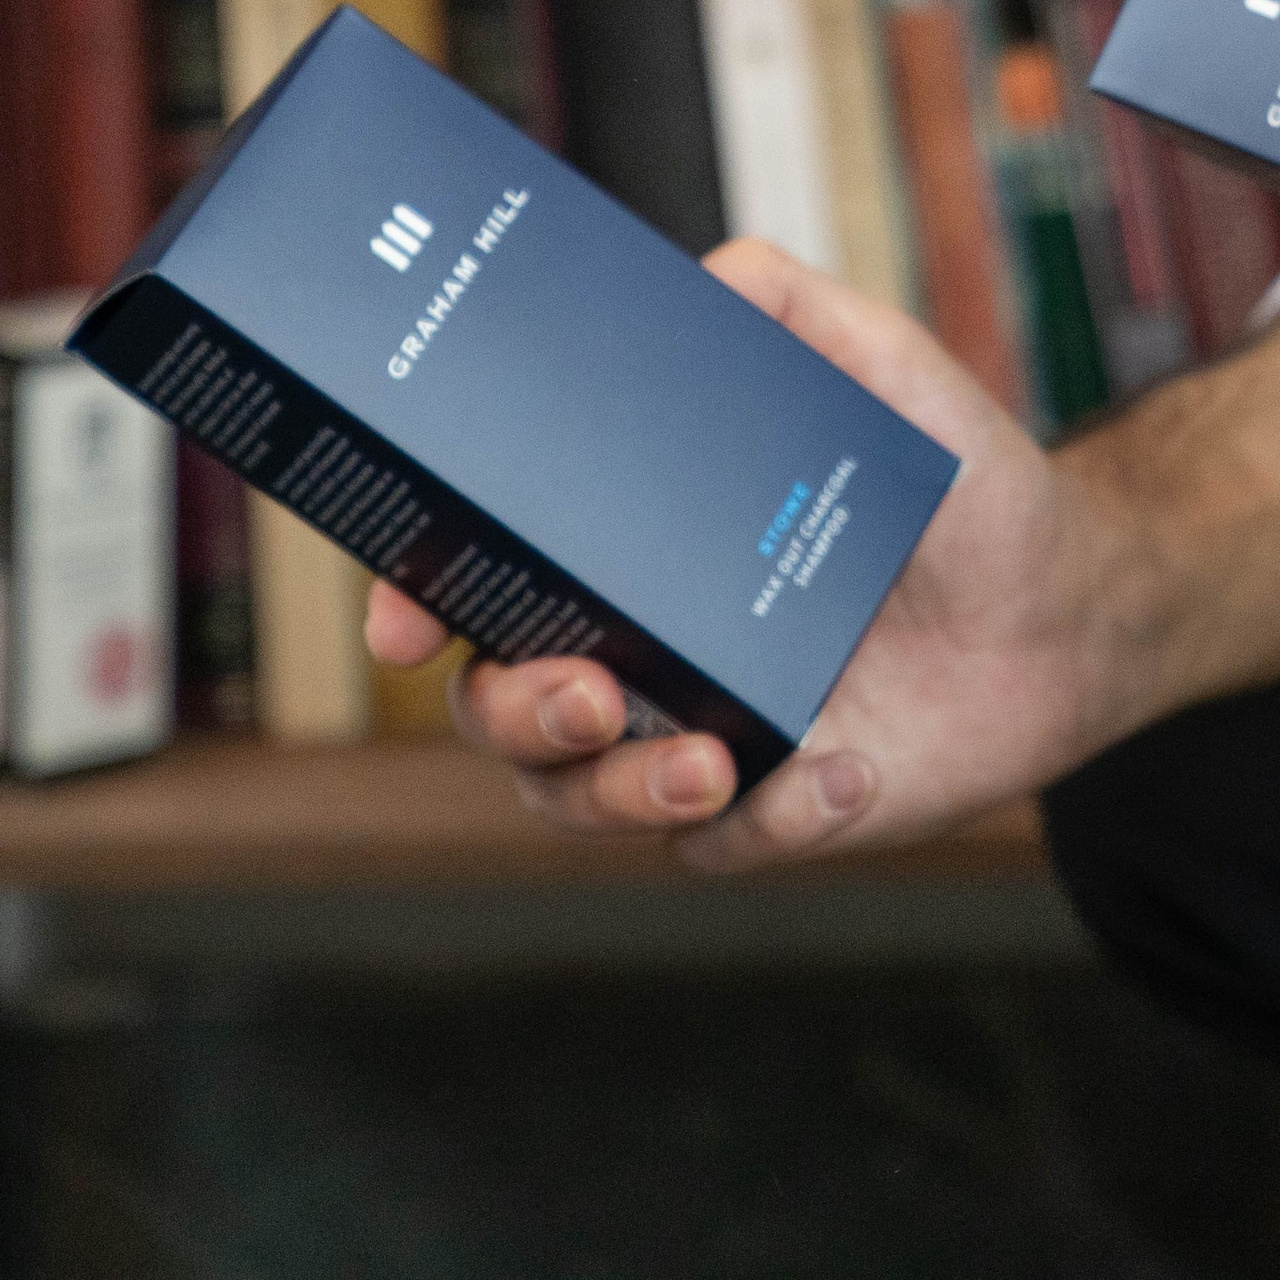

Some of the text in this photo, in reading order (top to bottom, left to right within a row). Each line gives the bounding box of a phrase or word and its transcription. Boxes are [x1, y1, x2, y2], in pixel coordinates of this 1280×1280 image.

[388, 189, 529, 379] GRAHAM HILL
[751, 458, 858, 617] WAX OUT CHARCOAL
[793, 507, 848, 588] SHAMPOO
